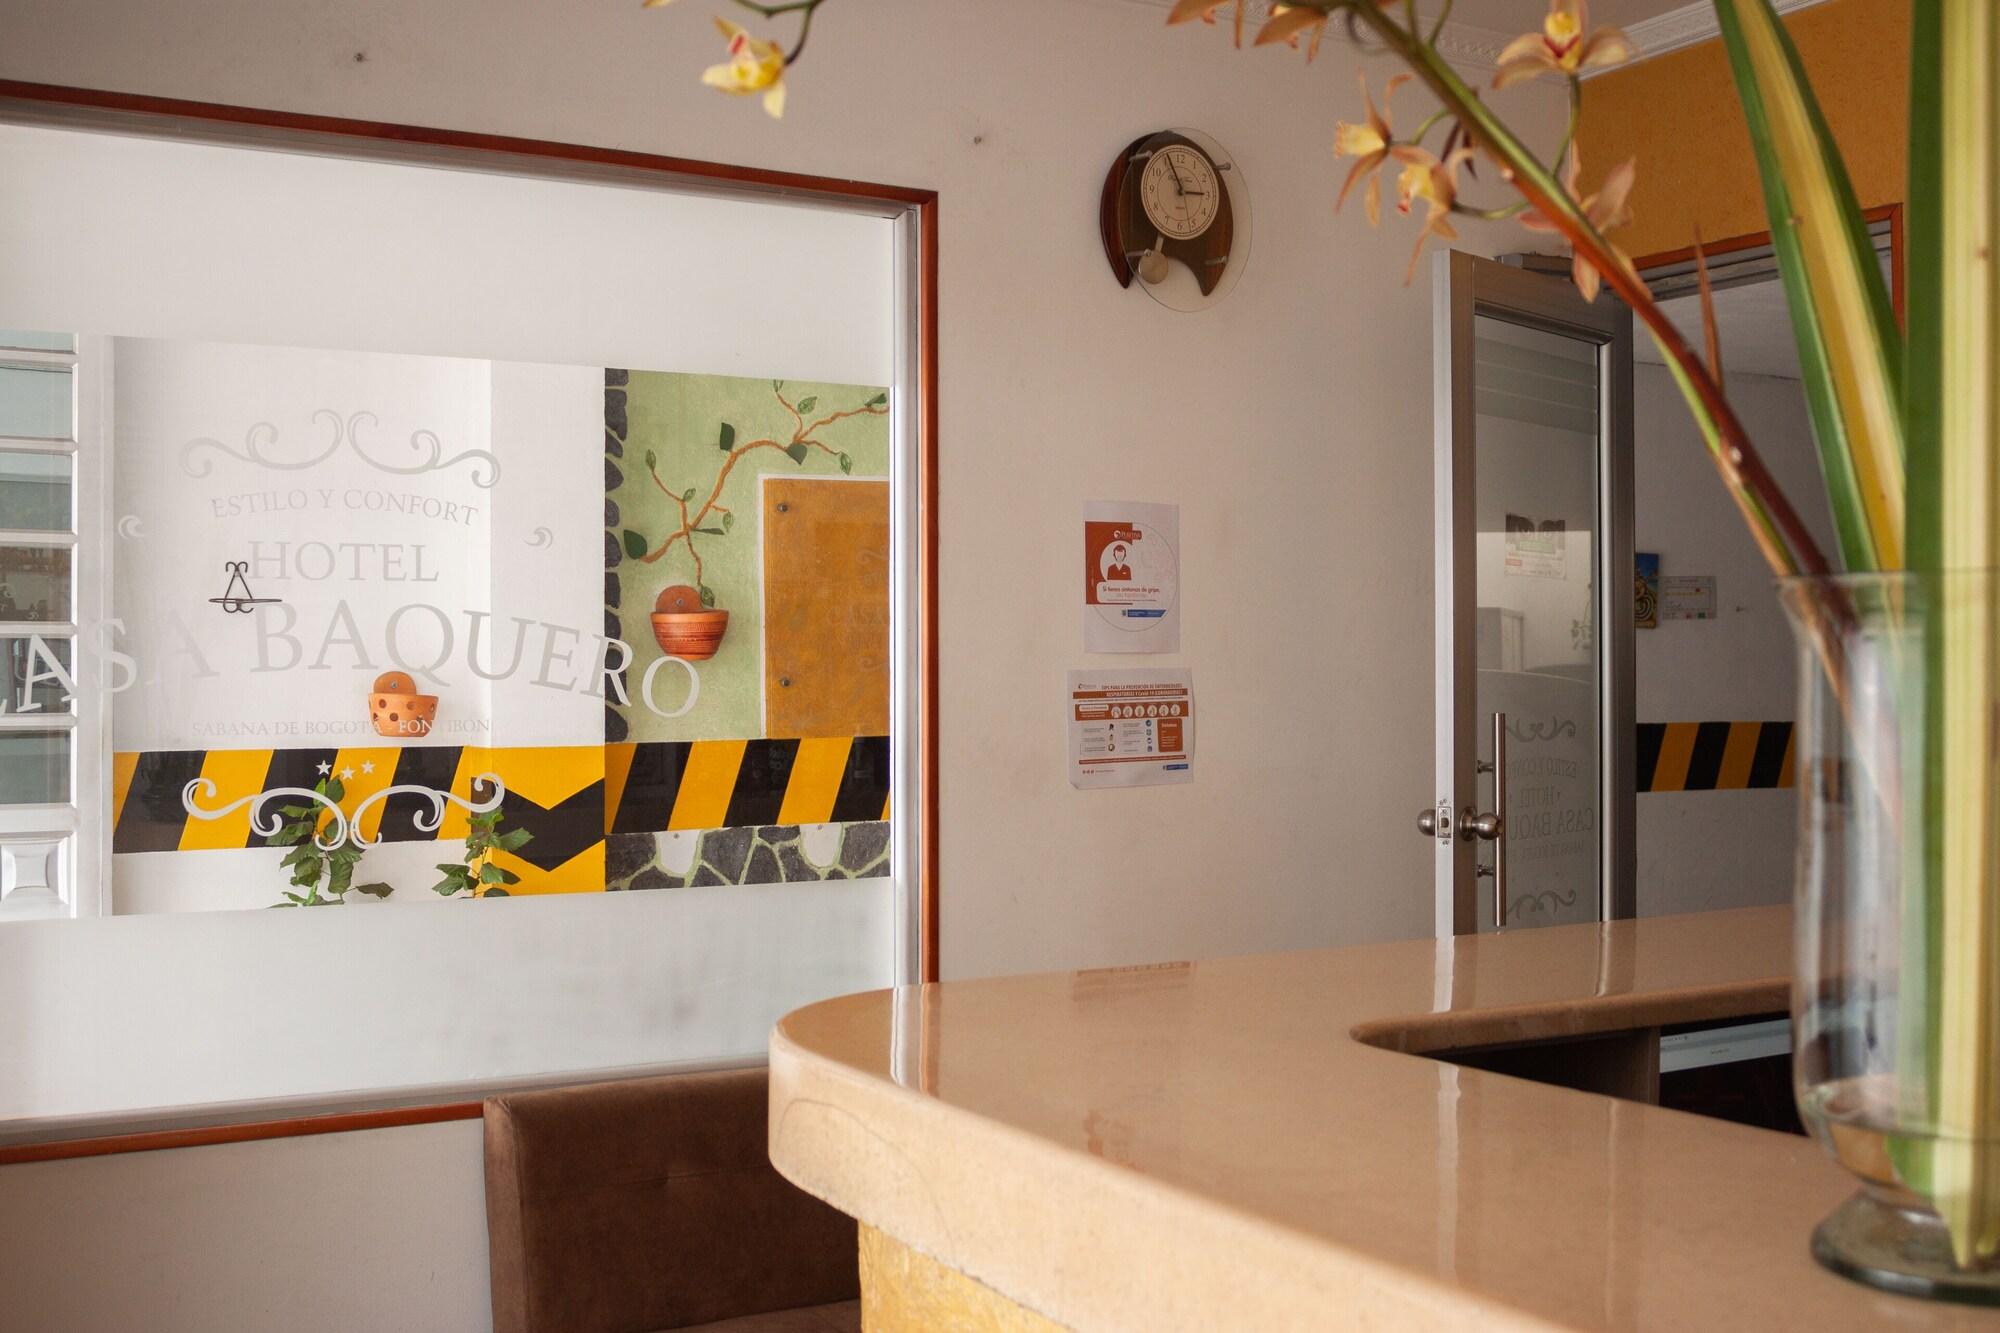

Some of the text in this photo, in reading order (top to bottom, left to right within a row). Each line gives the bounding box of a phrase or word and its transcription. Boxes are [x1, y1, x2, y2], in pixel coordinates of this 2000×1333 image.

[1152, 167, 1161, 177] 10
[1176, 154, 1185, 164] 12
[212, 488, 479, 526] ESTILO Y CONFORT
[248, 540, 439, 583] HOTEL
[0, 599, 700, 719] ASA BAQUERO
[191, 721, 270, 737] SABANA
[273, 721, 299, 735] DE
[399, 719, 489, 734] FONIBON
